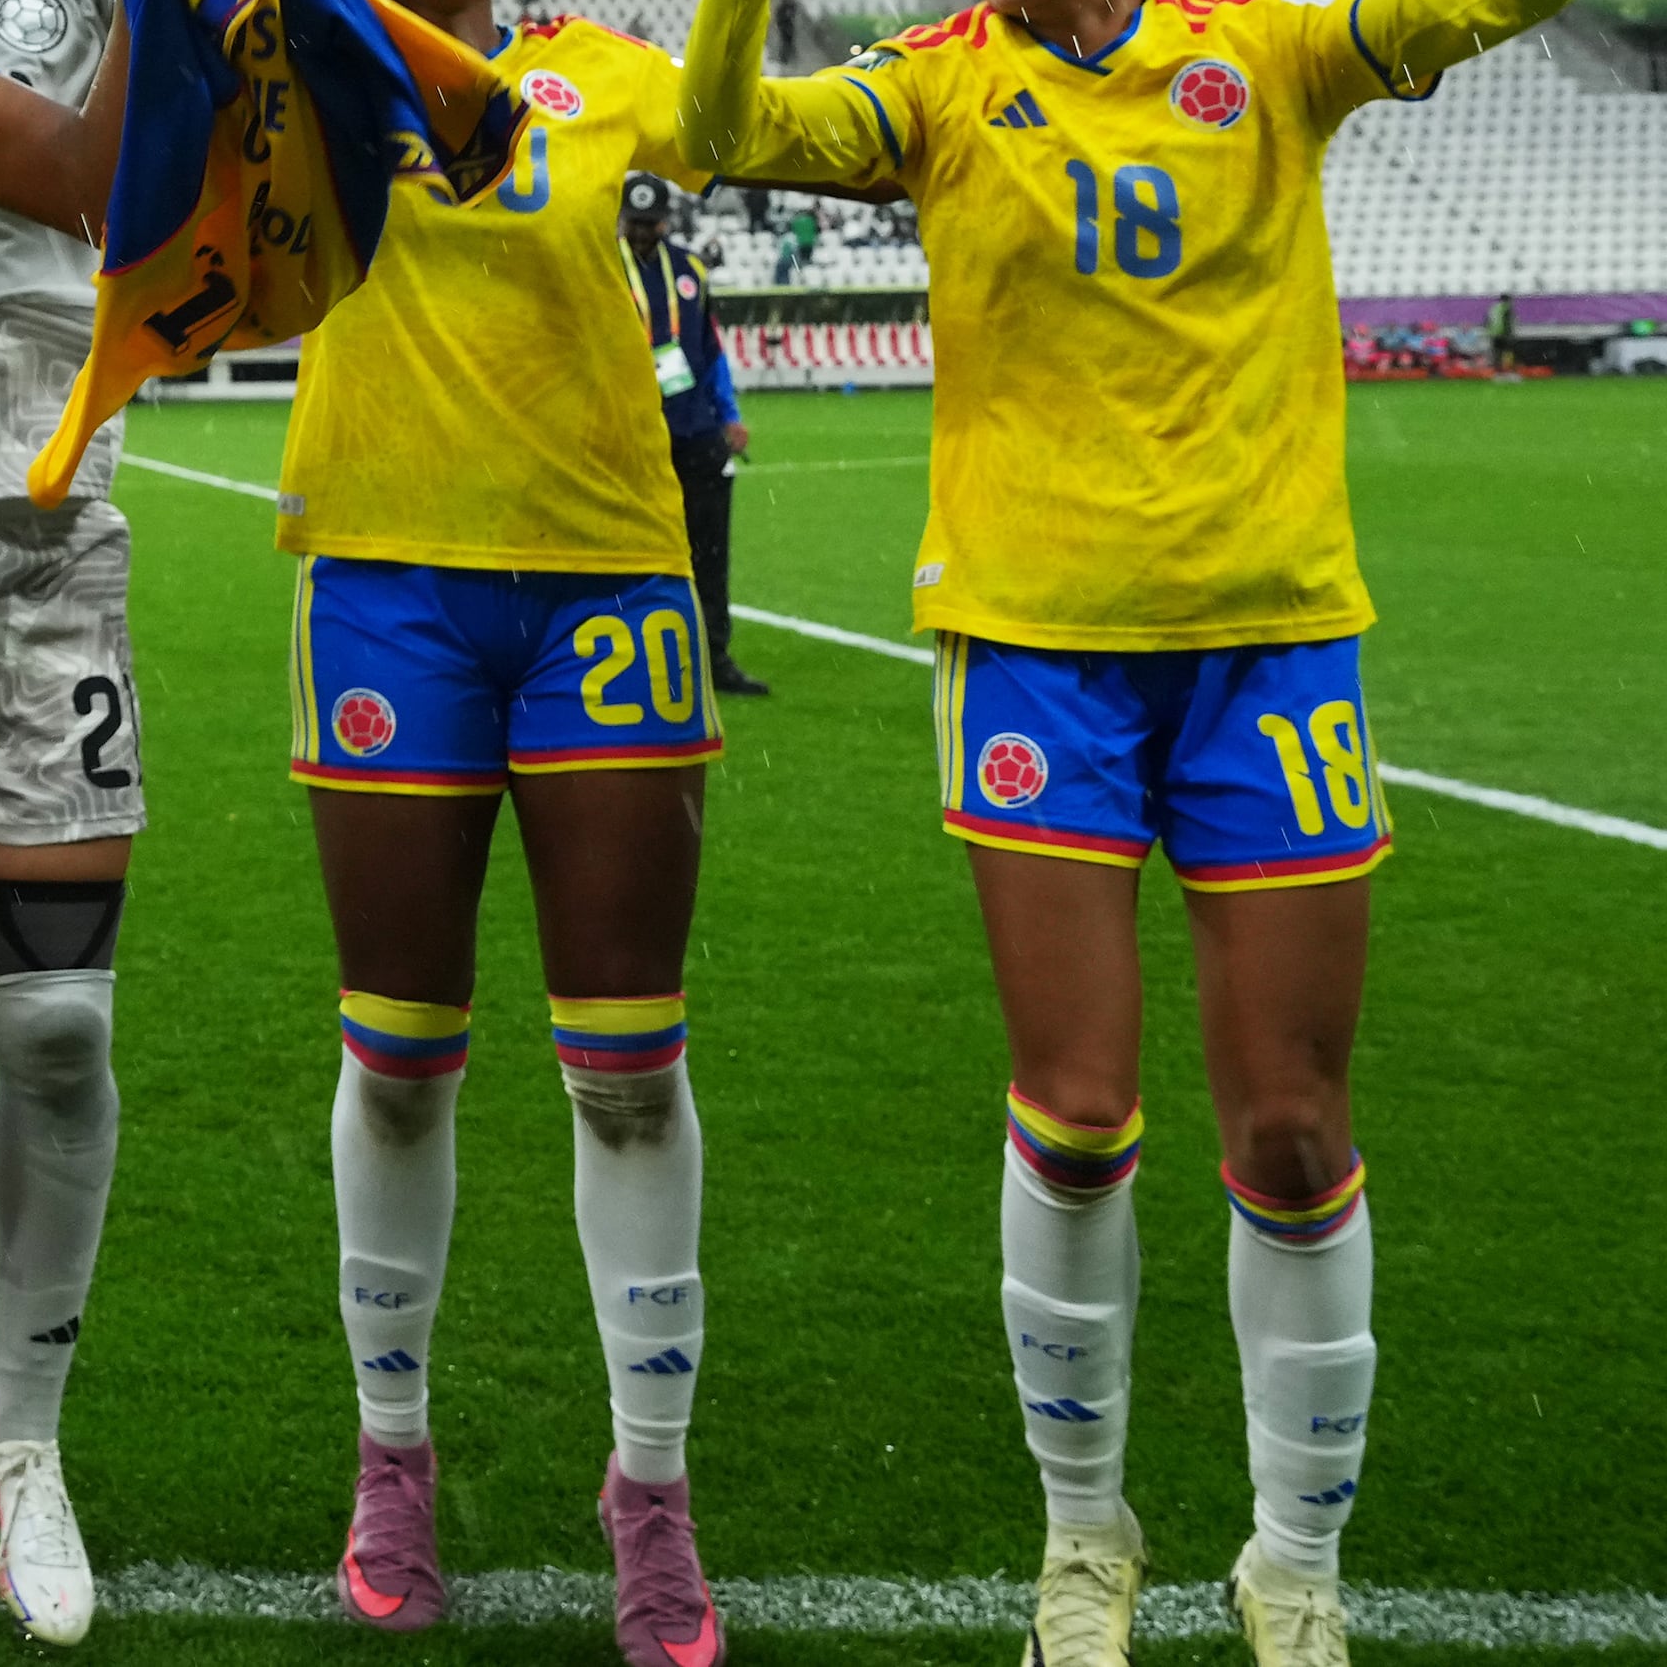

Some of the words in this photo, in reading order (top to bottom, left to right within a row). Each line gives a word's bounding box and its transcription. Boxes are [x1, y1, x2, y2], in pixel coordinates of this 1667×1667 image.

[1064, 157, 1184, 281] 18
[573, 608, 694, 727] 20
[72, 674, 143, 790] 2
[1256, 699, 1370, 837] 18
[354, 1286, 411, 1310] FCF
[627, 1285, 690, 1306] FCF
